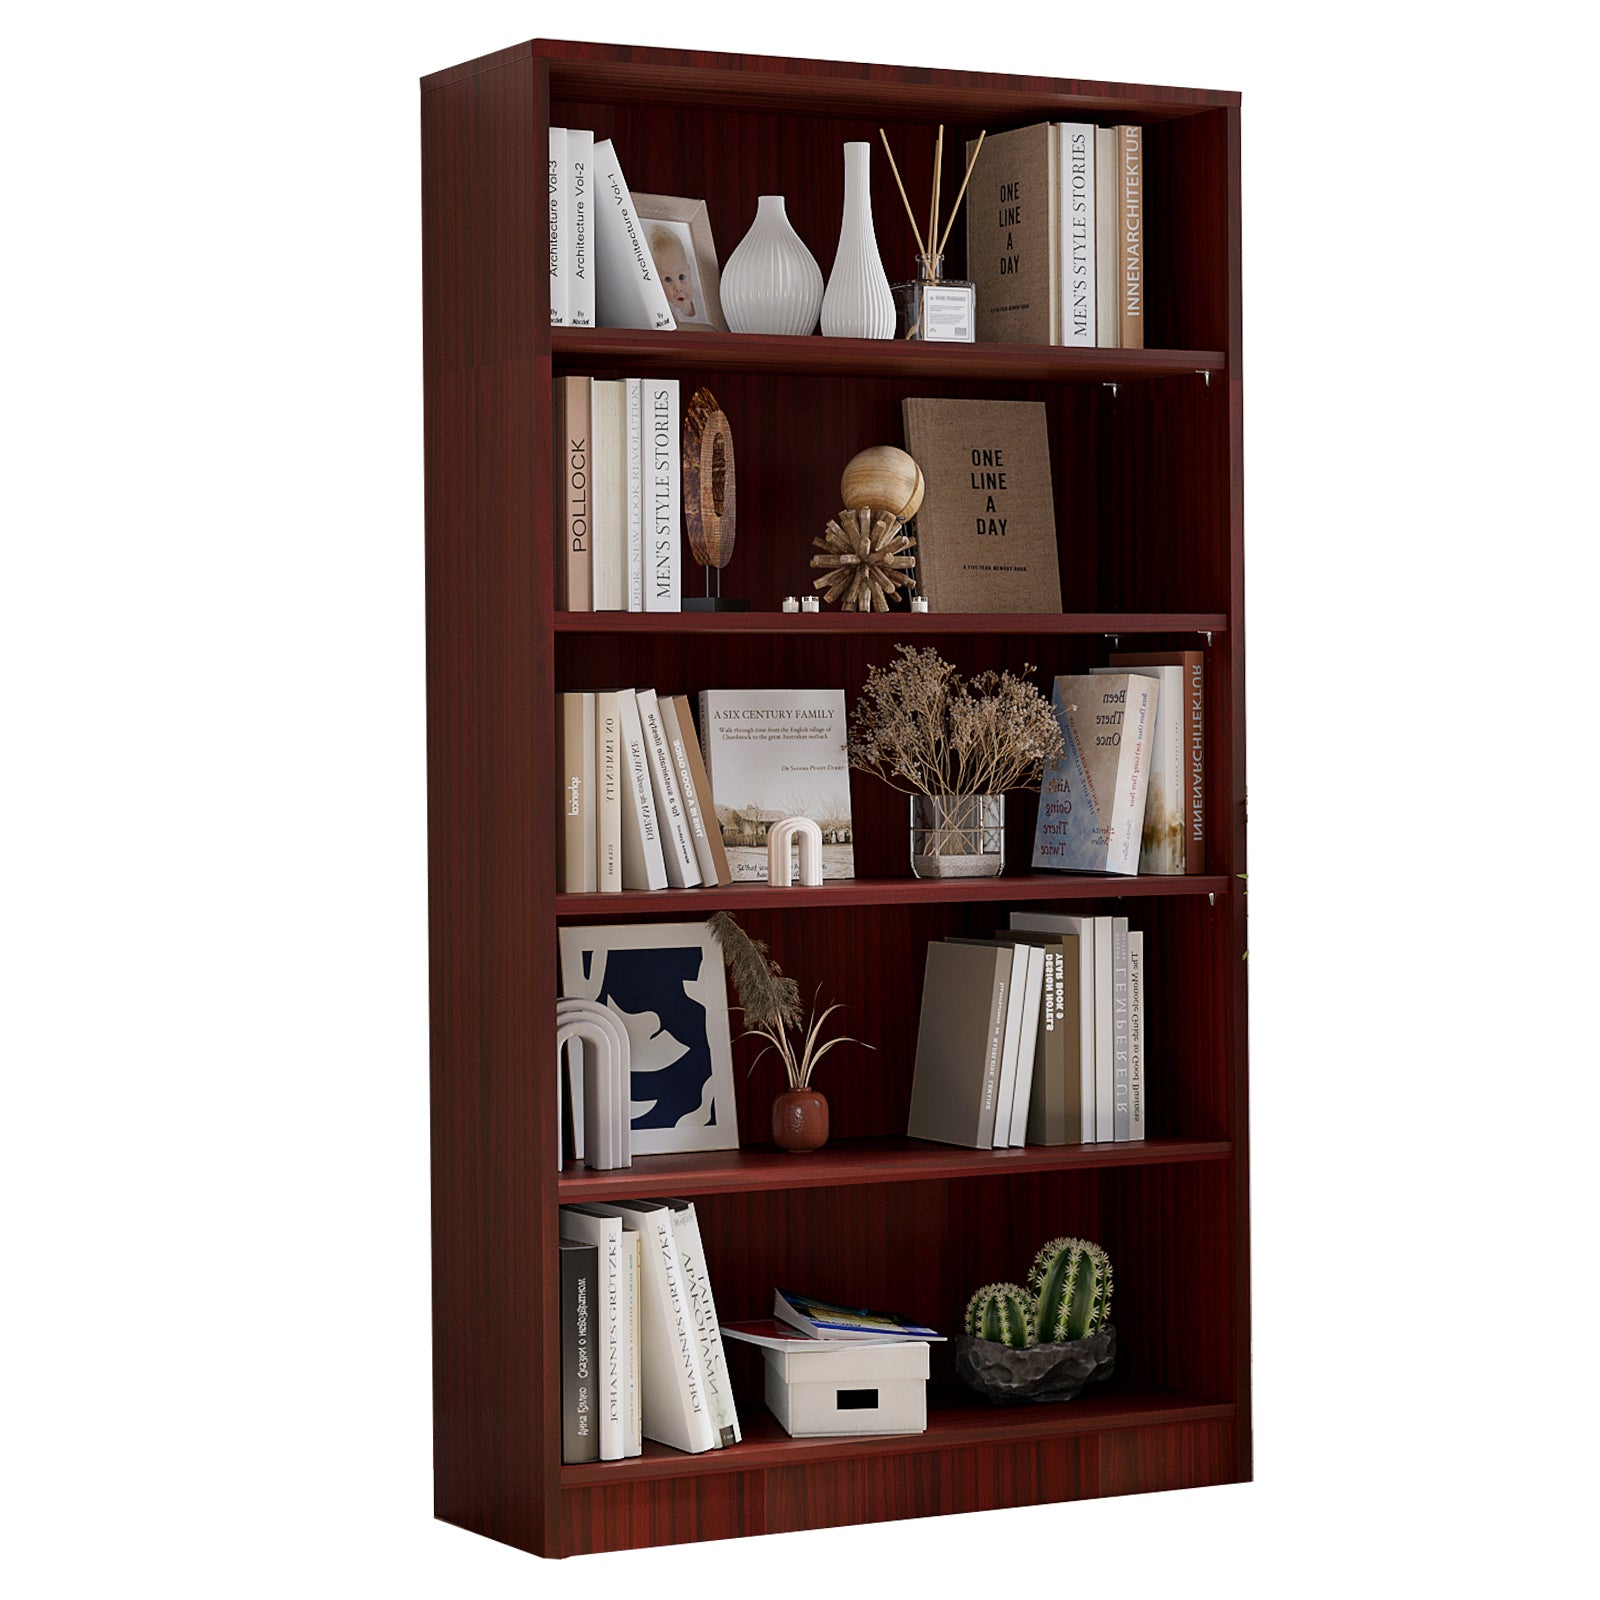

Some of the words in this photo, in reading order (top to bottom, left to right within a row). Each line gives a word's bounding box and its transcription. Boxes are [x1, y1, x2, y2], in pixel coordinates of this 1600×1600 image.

[550, 160, 558, 194] Vol-3
[575, 162, 585, 197] Vol-2
[607, 173, 623, 205] Vol-1
[1000, 182, 1020, 201] ONE
[1072, 133, 1087, 212] STORIES
[999, 206, 1021, 228] LINE
[1126, 126, 1140, 316] INNENARCHITEKTUR
[550, 199, 558, 277] Architecture
[575, 201, 585, 279] Architecture
[622, 208, 651, 281] Architecture
[1006, 232, 1013, 250] A
[1073, 217, 1087, 275] STYLE
[1000, 255, 1020, 275] DAY
[1074, 280, 1087, 336] MEN'S
[631, 385, 640, 480] REVOLUTION
[654, 390, 669, 470] STORIES
[972, 449, 1003, 467] ONE
[571, 438, 587, 552] POLLOCK
[971, 473, 1007, 490] LINE
[632, 486, 640, 524] LOOK
[656, 476, 670, 535] STYLE
[986, 495, 996, 513] A
[632, 530, 640, 562] NEW
[977, 518, 1007, 536] DAY
[656, 541, 671, 599] MEN'S
[714, 711, 722, 719] A
[723, 711, 740, 719] SIX
[742, 710, 793, 719] CENTURY
[795, 709, 835, 719] FAMILY
[577, 1346, 588, 1379] Сказки
[609, 1323, 619, 1423] JOHANNES
[675, 1315, 701, 1414] JOHANNES
